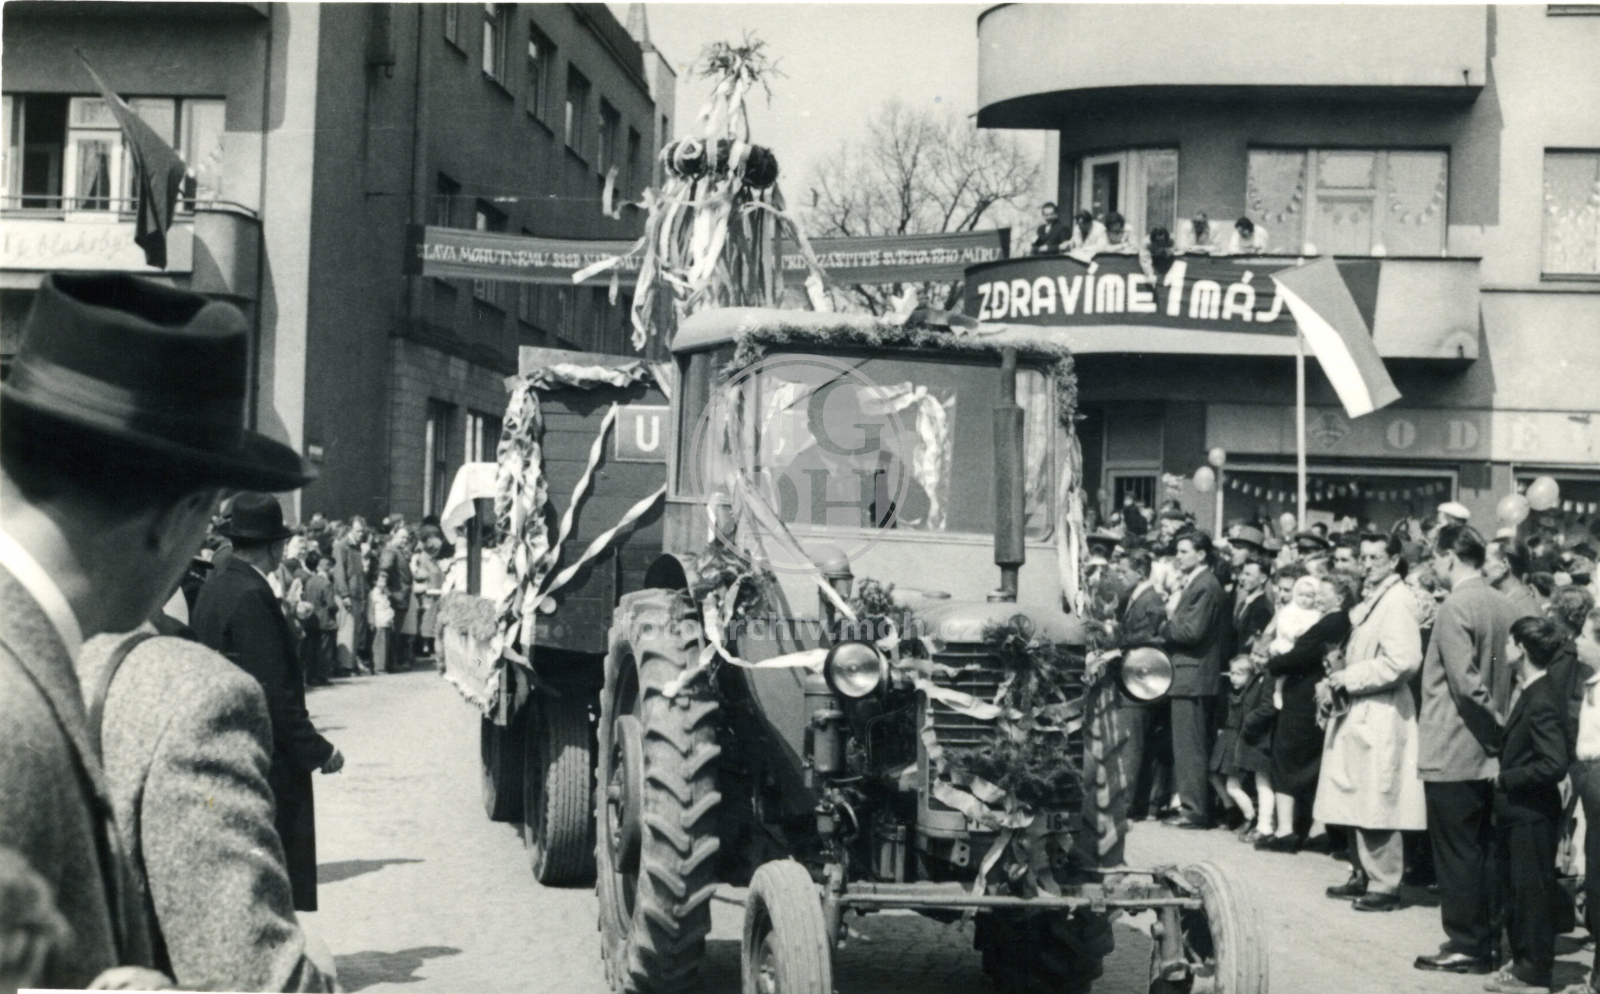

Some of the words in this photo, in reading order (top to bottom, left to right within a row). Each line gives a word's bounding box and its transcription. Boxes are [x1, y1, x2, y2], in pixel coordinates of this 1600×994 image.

[977, 260, 1158, 322] ZDRAVÍME
[1163, 260, 1188, 317] 1
[1188, 270, 1286, 323] MÁJ
